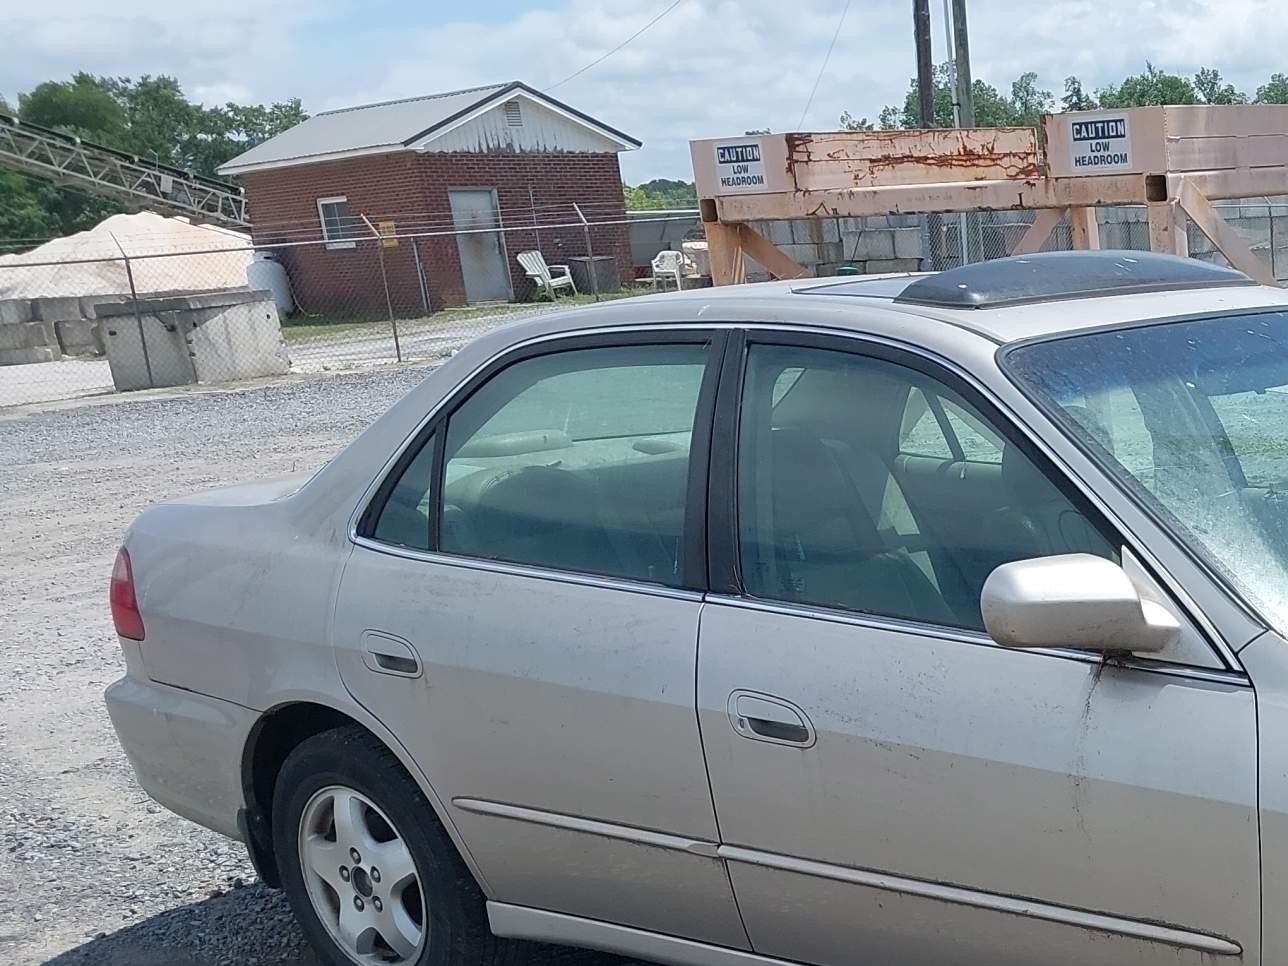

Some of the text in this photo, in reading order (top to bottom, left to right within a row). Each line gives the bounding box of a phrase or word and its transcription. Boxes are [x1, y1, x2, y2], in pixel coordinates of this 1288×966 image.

[1073, 121, 1125, 138] CAUTION
[1089, 141, 1110, 152] LOW
[718, 147, 760, 162] CAUTION
[1074, 153, 1128, 167] HEADROOM
[732, 164, 749, 175] LOW
[720, 175, 765, 187] HEADROOM
